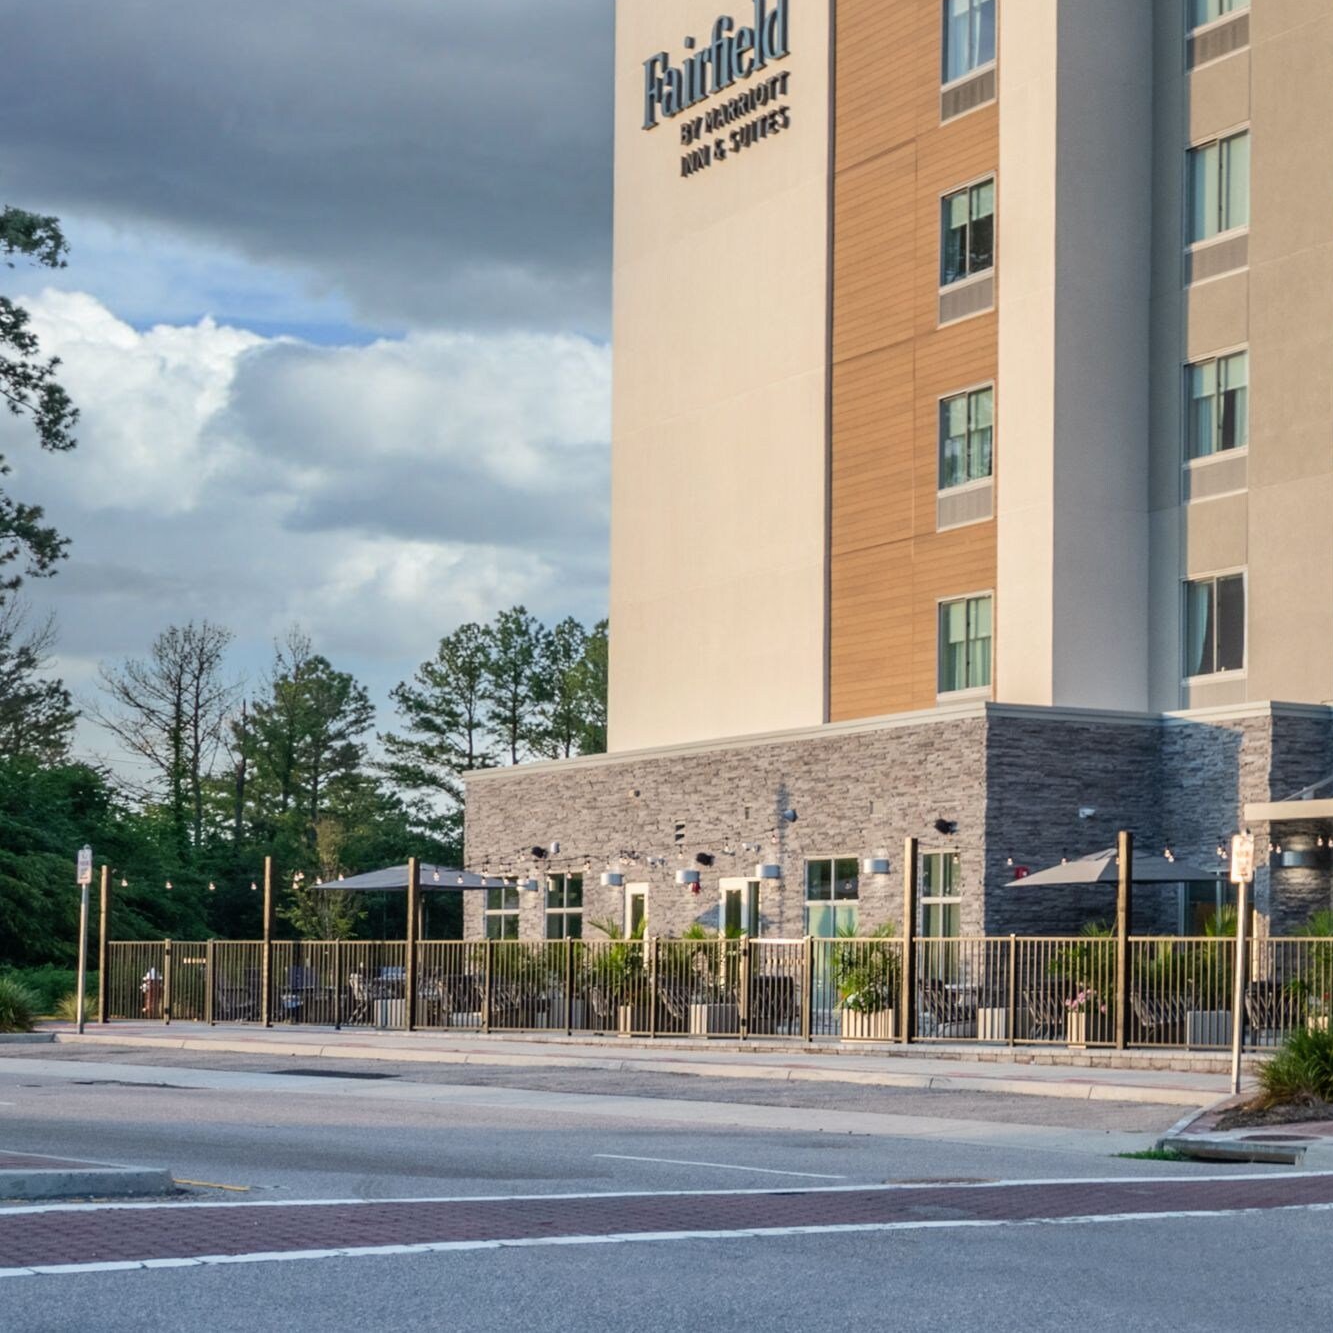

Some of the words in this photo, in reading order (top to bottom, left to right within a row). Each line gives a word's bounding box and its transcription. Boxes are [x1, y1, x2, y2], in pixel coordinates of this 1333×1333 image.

[680, 116, 703, 146] BY
[704, 70, 791, 134] MARRIOTT
[680, 144, 711, 178] INN
[713, 137, 727, 161] &
[729, 105, 791, 153] SUITES
